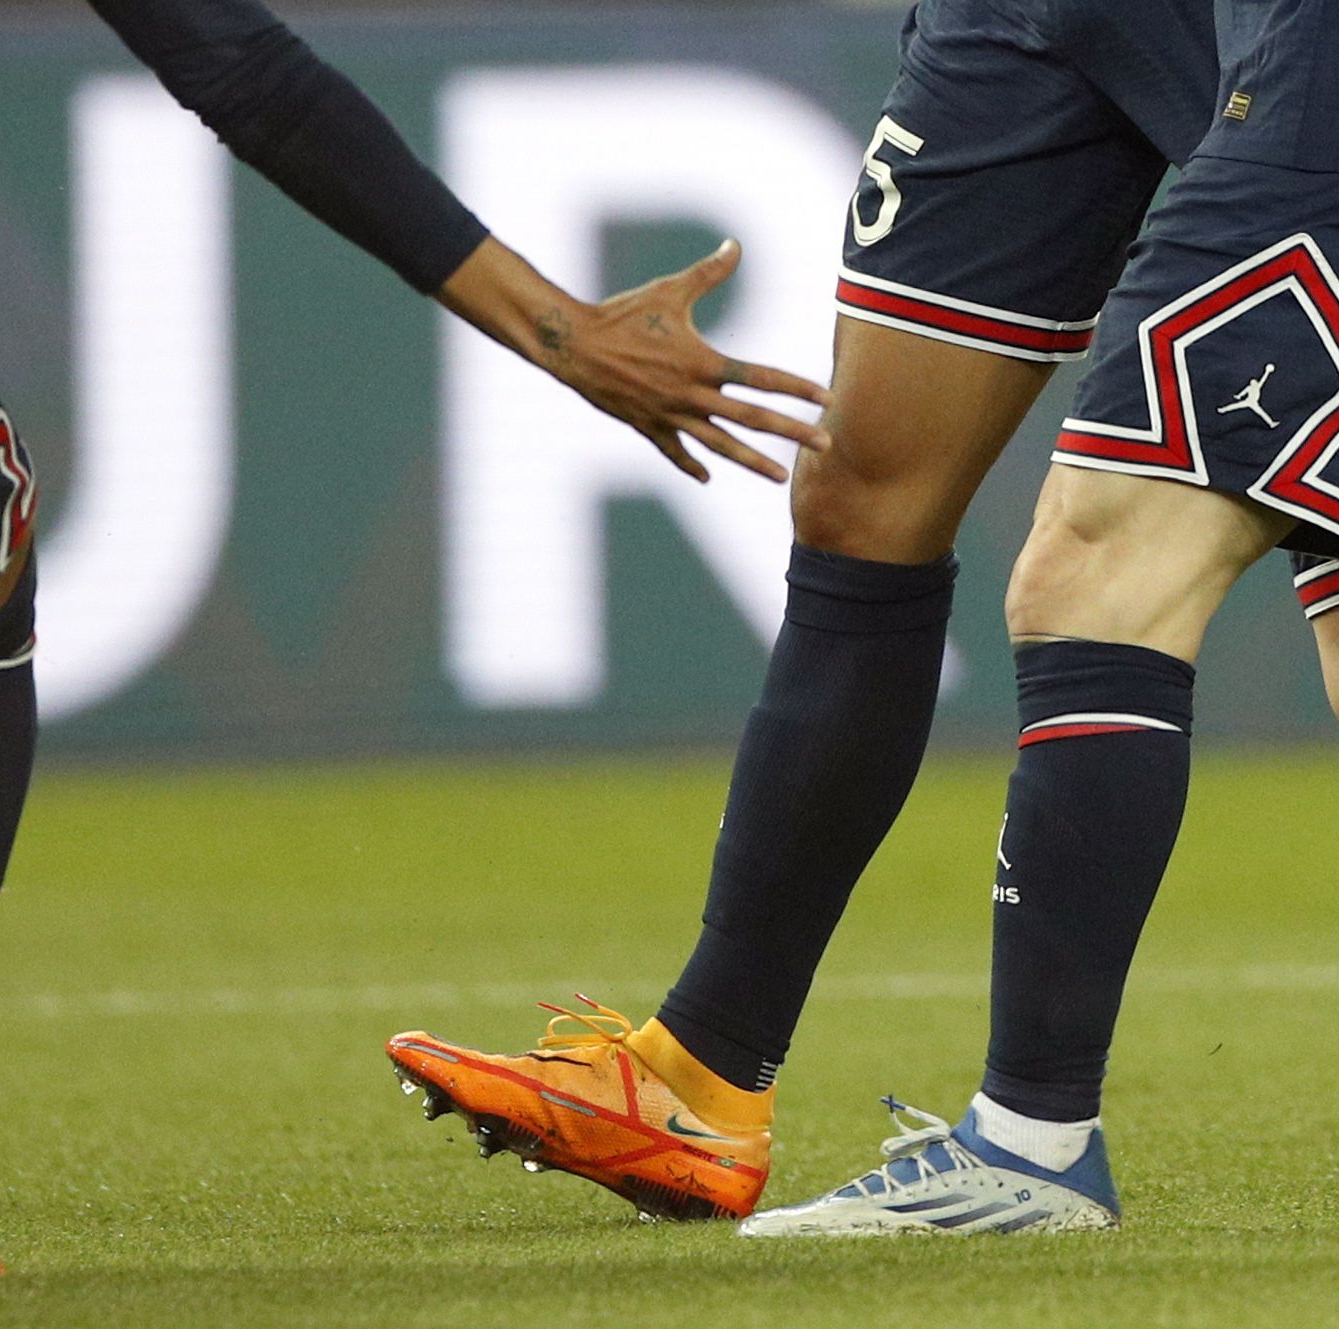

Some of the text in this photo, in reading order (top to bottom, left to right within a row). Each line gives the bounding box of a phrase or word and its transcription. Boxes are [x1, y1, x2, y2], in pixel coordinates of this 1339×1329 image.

[852, 115, 925, 247] 5
[992, 883, 1021, 904] RIS
[1014, 1189, 1031, 1204] 10
